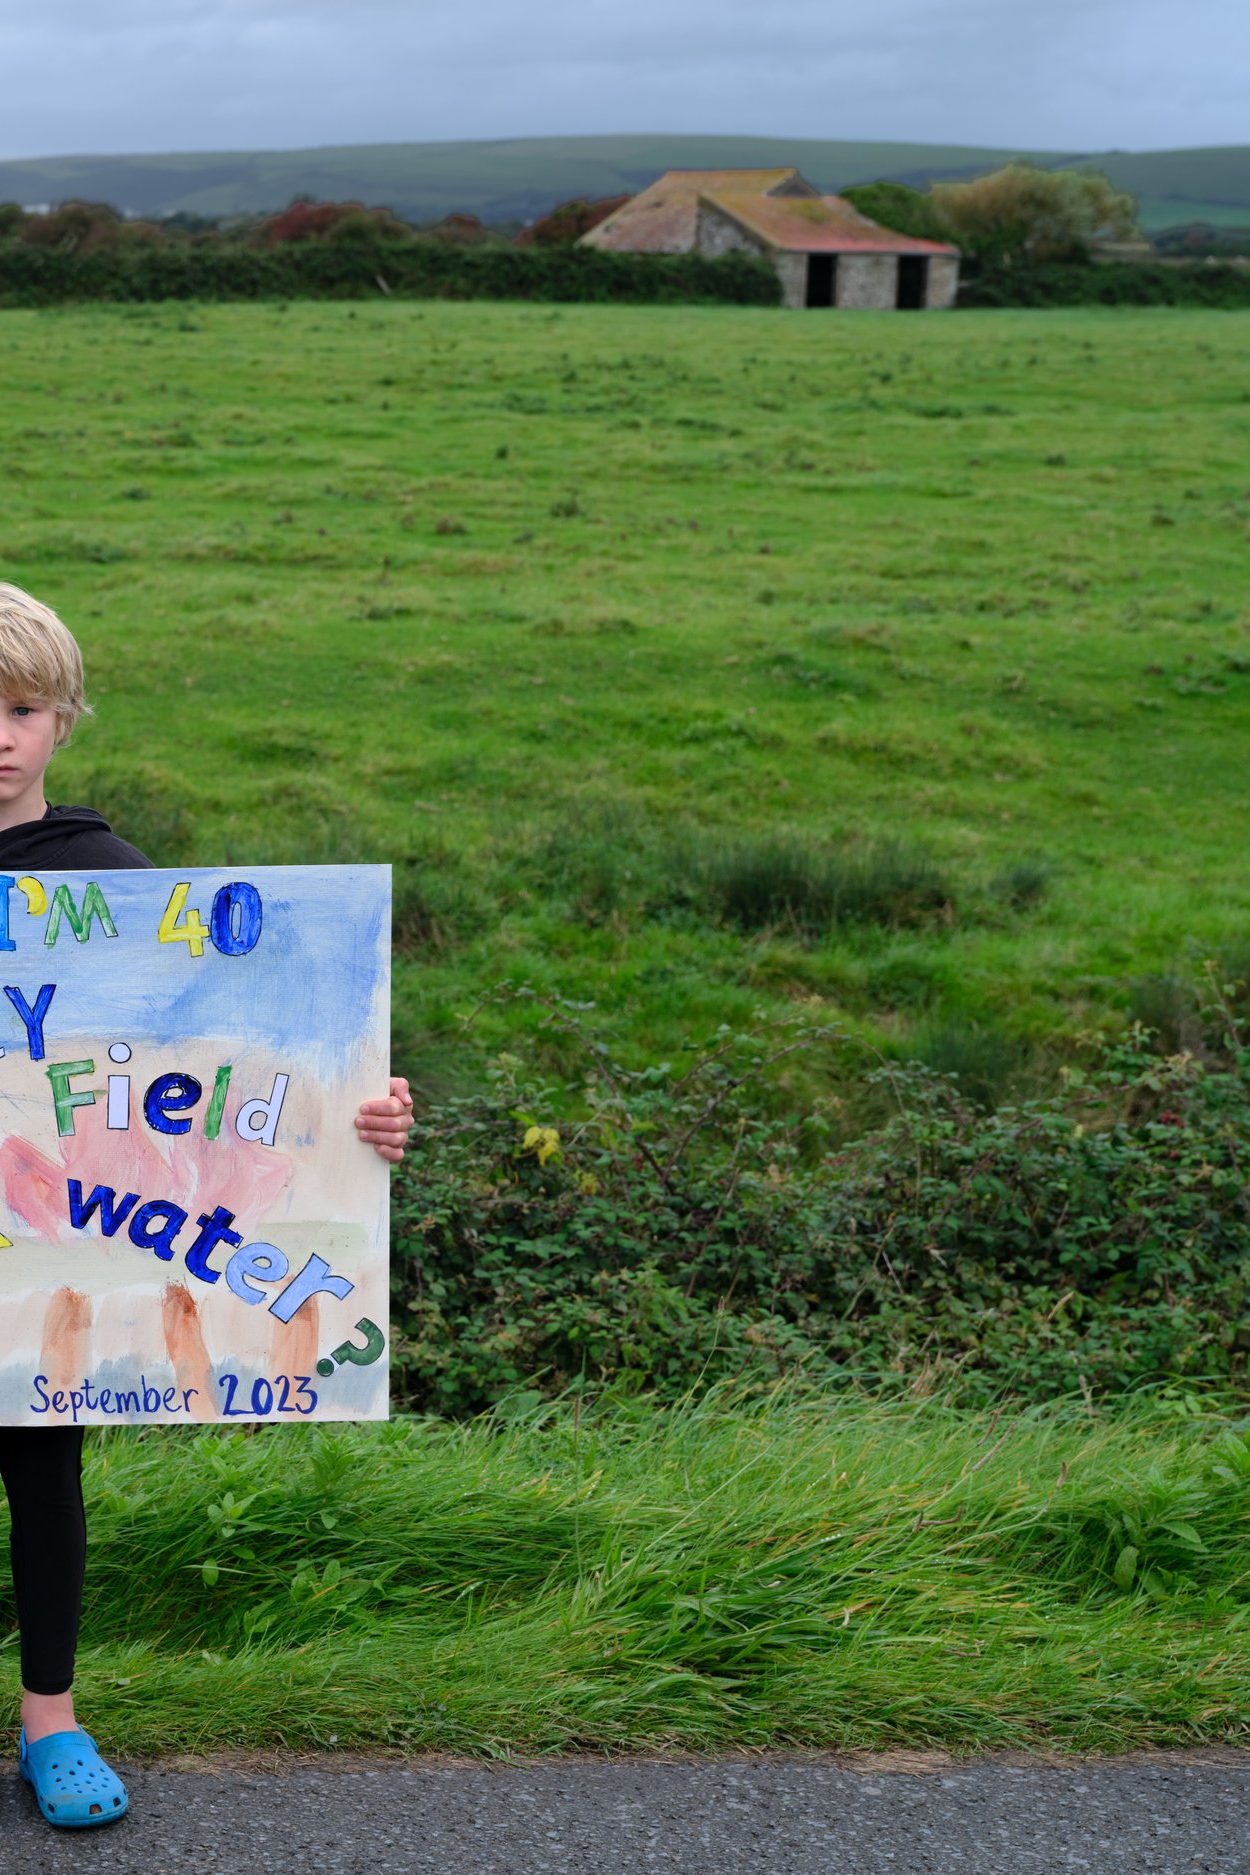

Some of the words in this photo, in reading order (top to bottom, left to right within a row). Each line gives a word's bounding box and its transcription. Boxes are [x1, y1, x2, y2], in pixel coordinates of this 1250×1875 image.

[158, 881, 263, 956] 40
[46, 1042, 290, 1147] Field
[30, 1374, 199, 1423] September
[218, 1373, 319, 1416] 2023
